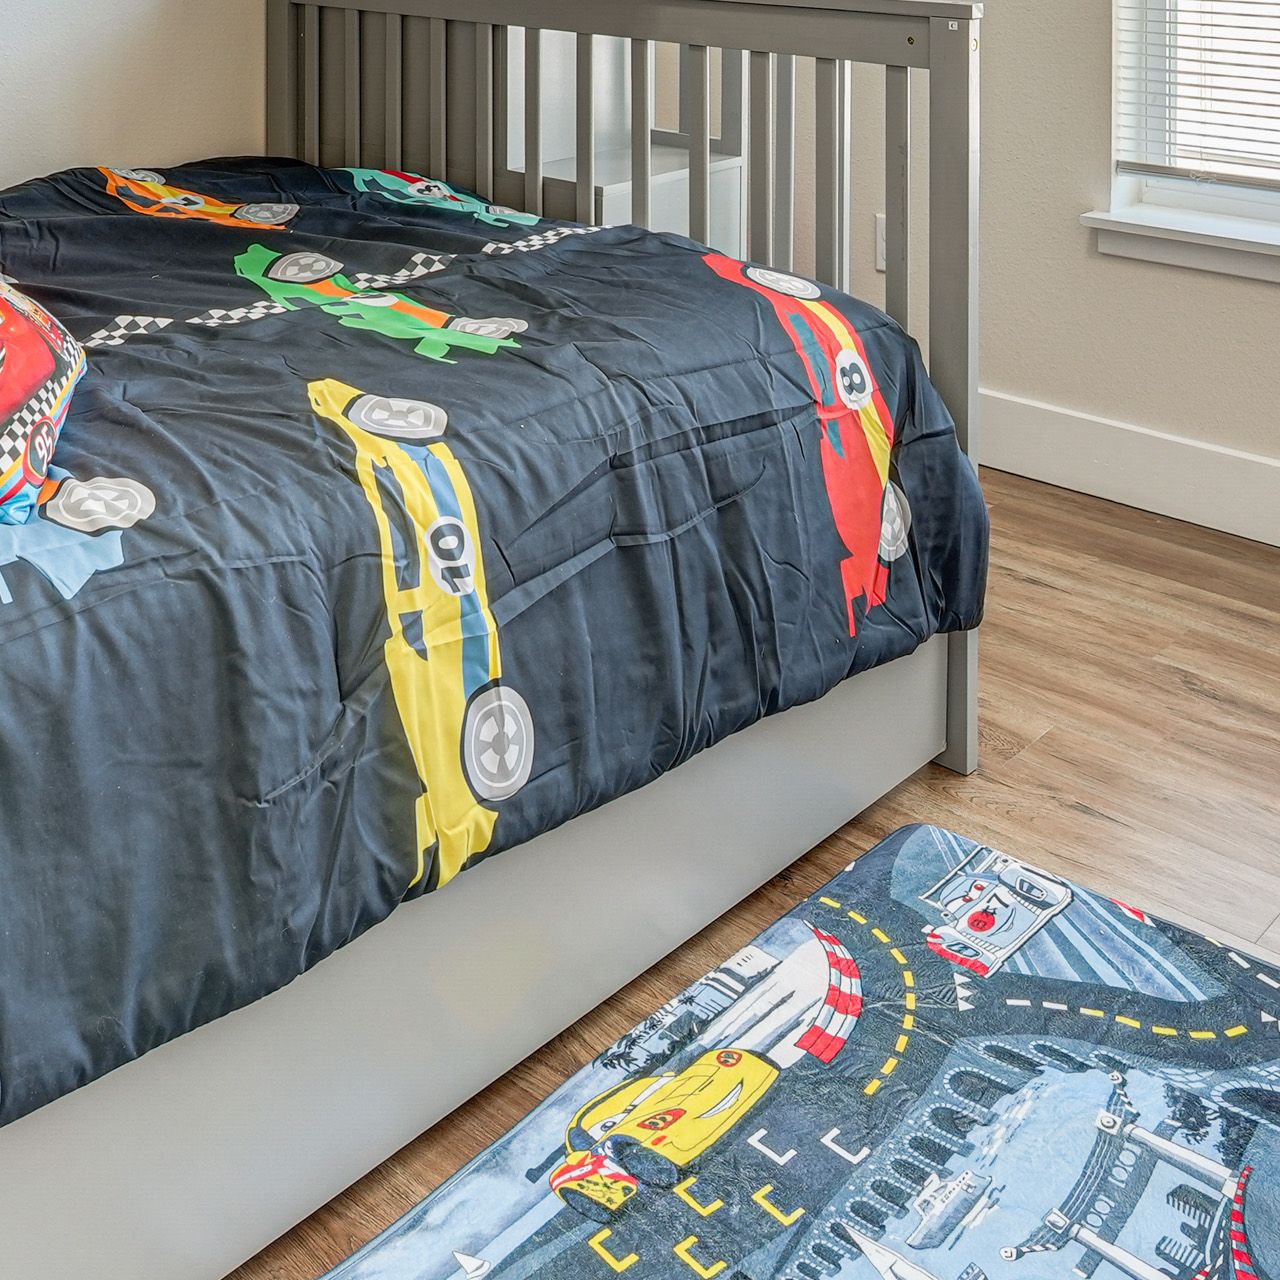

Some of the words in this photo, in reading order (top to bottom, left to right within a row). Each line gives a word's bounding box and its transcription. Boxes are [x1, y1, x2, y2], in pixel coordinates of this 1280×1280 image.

[839, 362, 867, 396] 8
[34, 424, 54, 475] 95
[430, 523, 471, 594] 10
